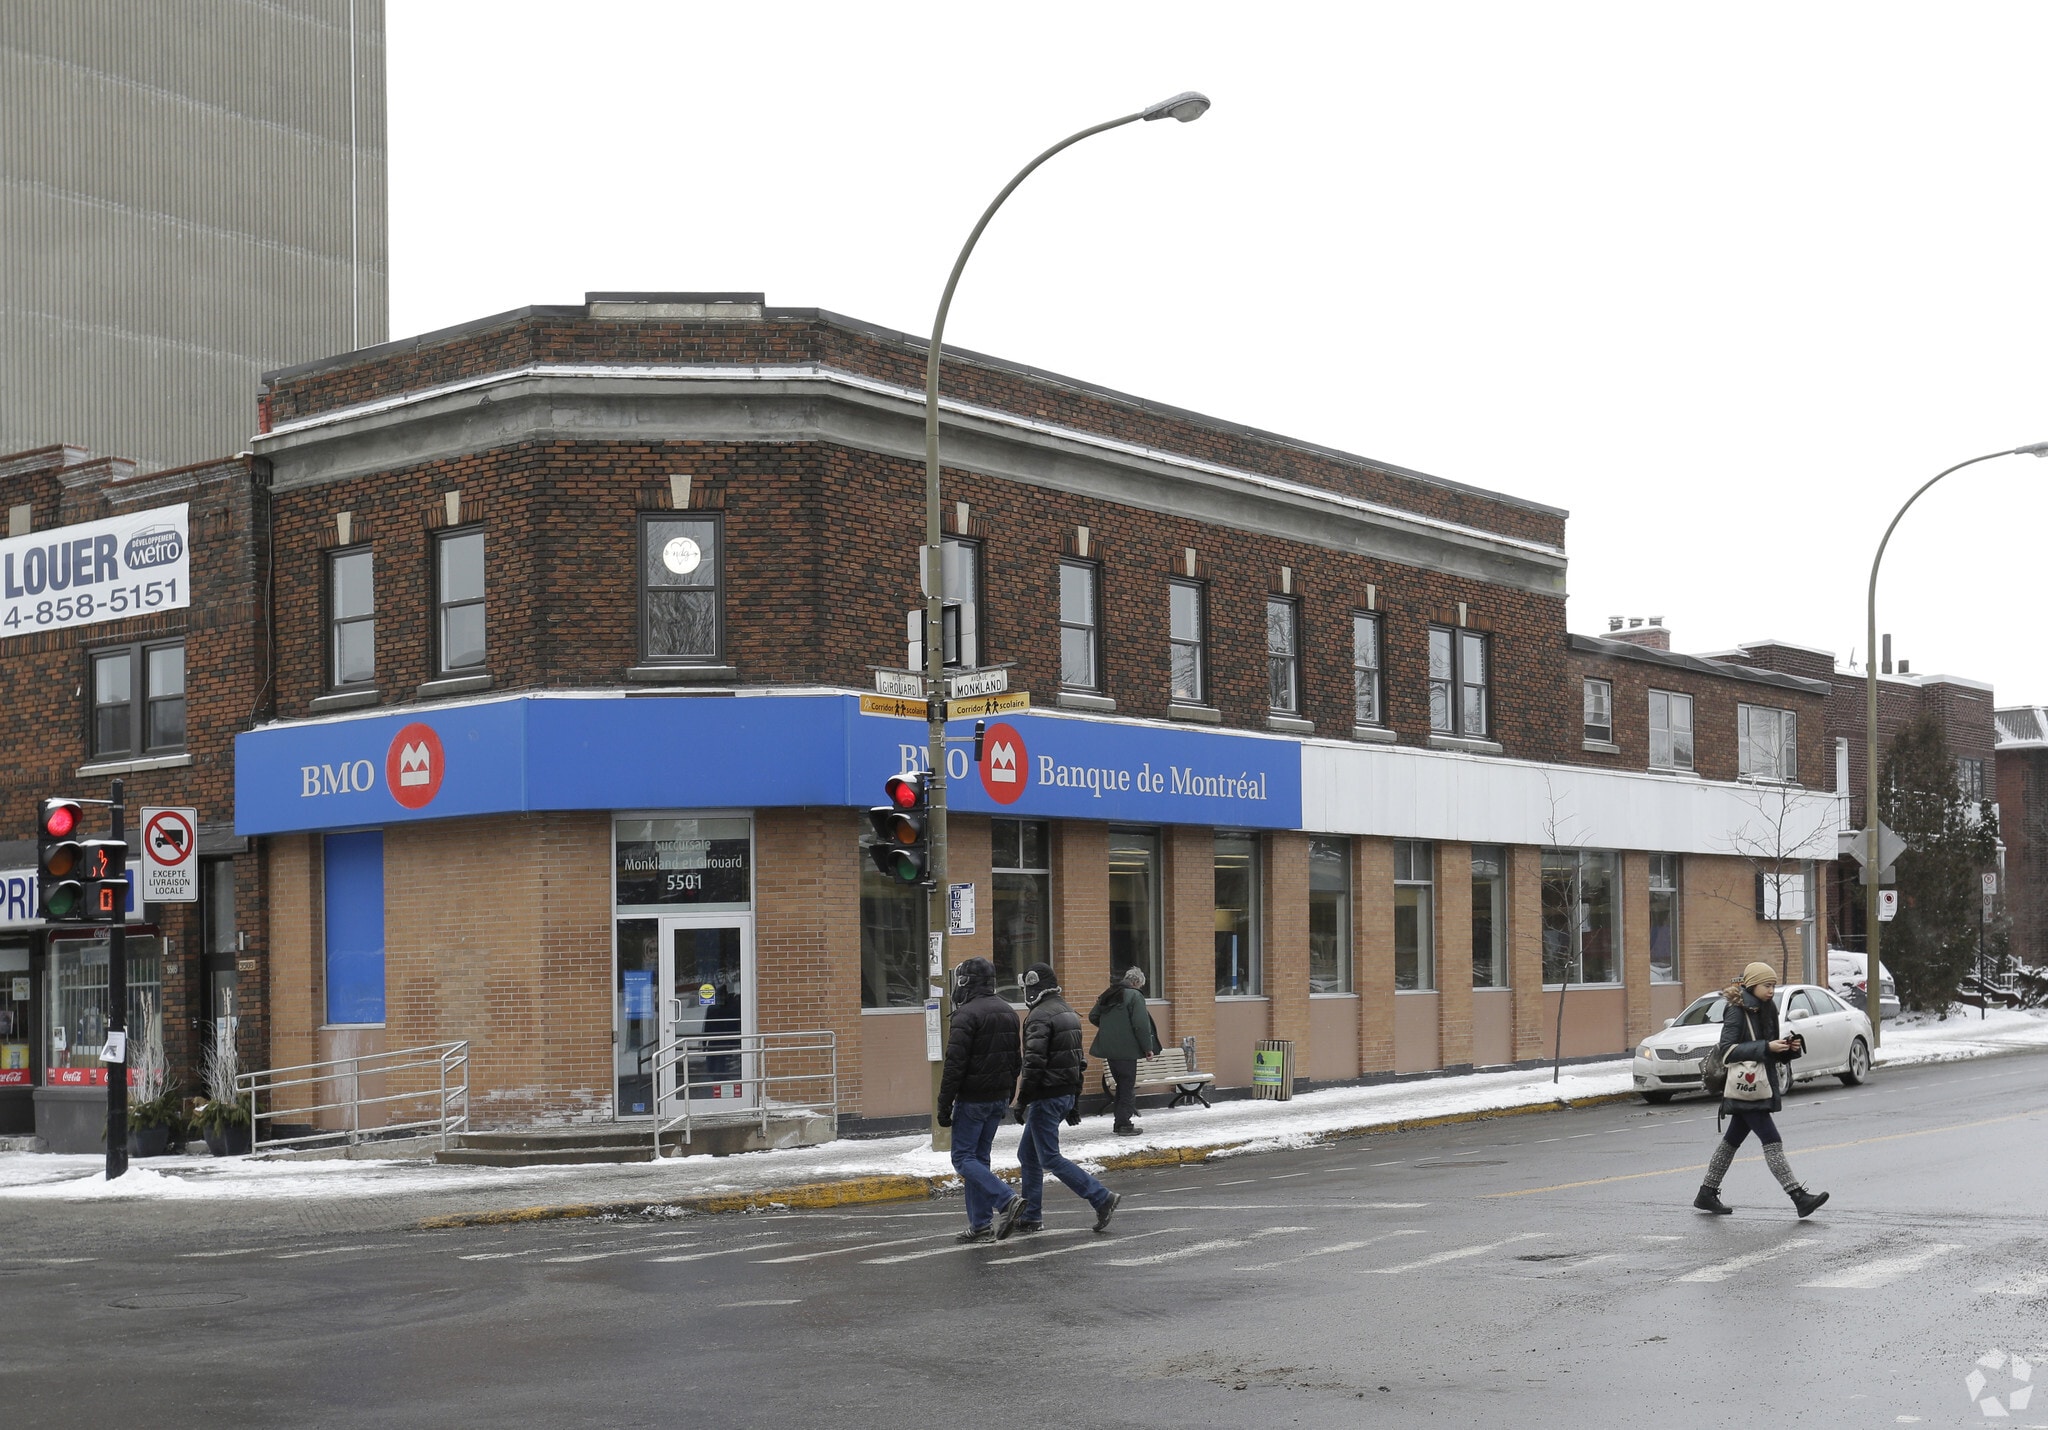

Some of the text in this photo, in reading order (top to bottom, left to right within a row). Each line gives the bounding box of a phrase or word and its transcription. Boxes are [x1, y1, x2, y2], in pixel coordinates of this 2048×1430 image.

[131, 532, 176, 548] DÉVELOPPEMENT
[5, 534, 119, 599] LOUER
[3, 578, 177, 629] 4-858-5151
[882, 681, 917, 696] GIROUARD
[957, 679, 1002, 697] MONKLAND
[871, 702, 926, 715] Corridor scolaire
[956, 700, 1025, 714] Corridor scolaire
[300, 759, 375, 798] BMO
[1037, 755, 1267, 800] Banque de Montréal
[655, 840, 711, 852] Succursale
[624, 854, 742, 870] Monkland et Girouard
[152, 869, 187, 878] EXCEPTÉ
[149, 878, 191, 886] LIVRAISON
[666, 874, 702, 890] 5501
[155, 887, 184, 895] LOCALE
